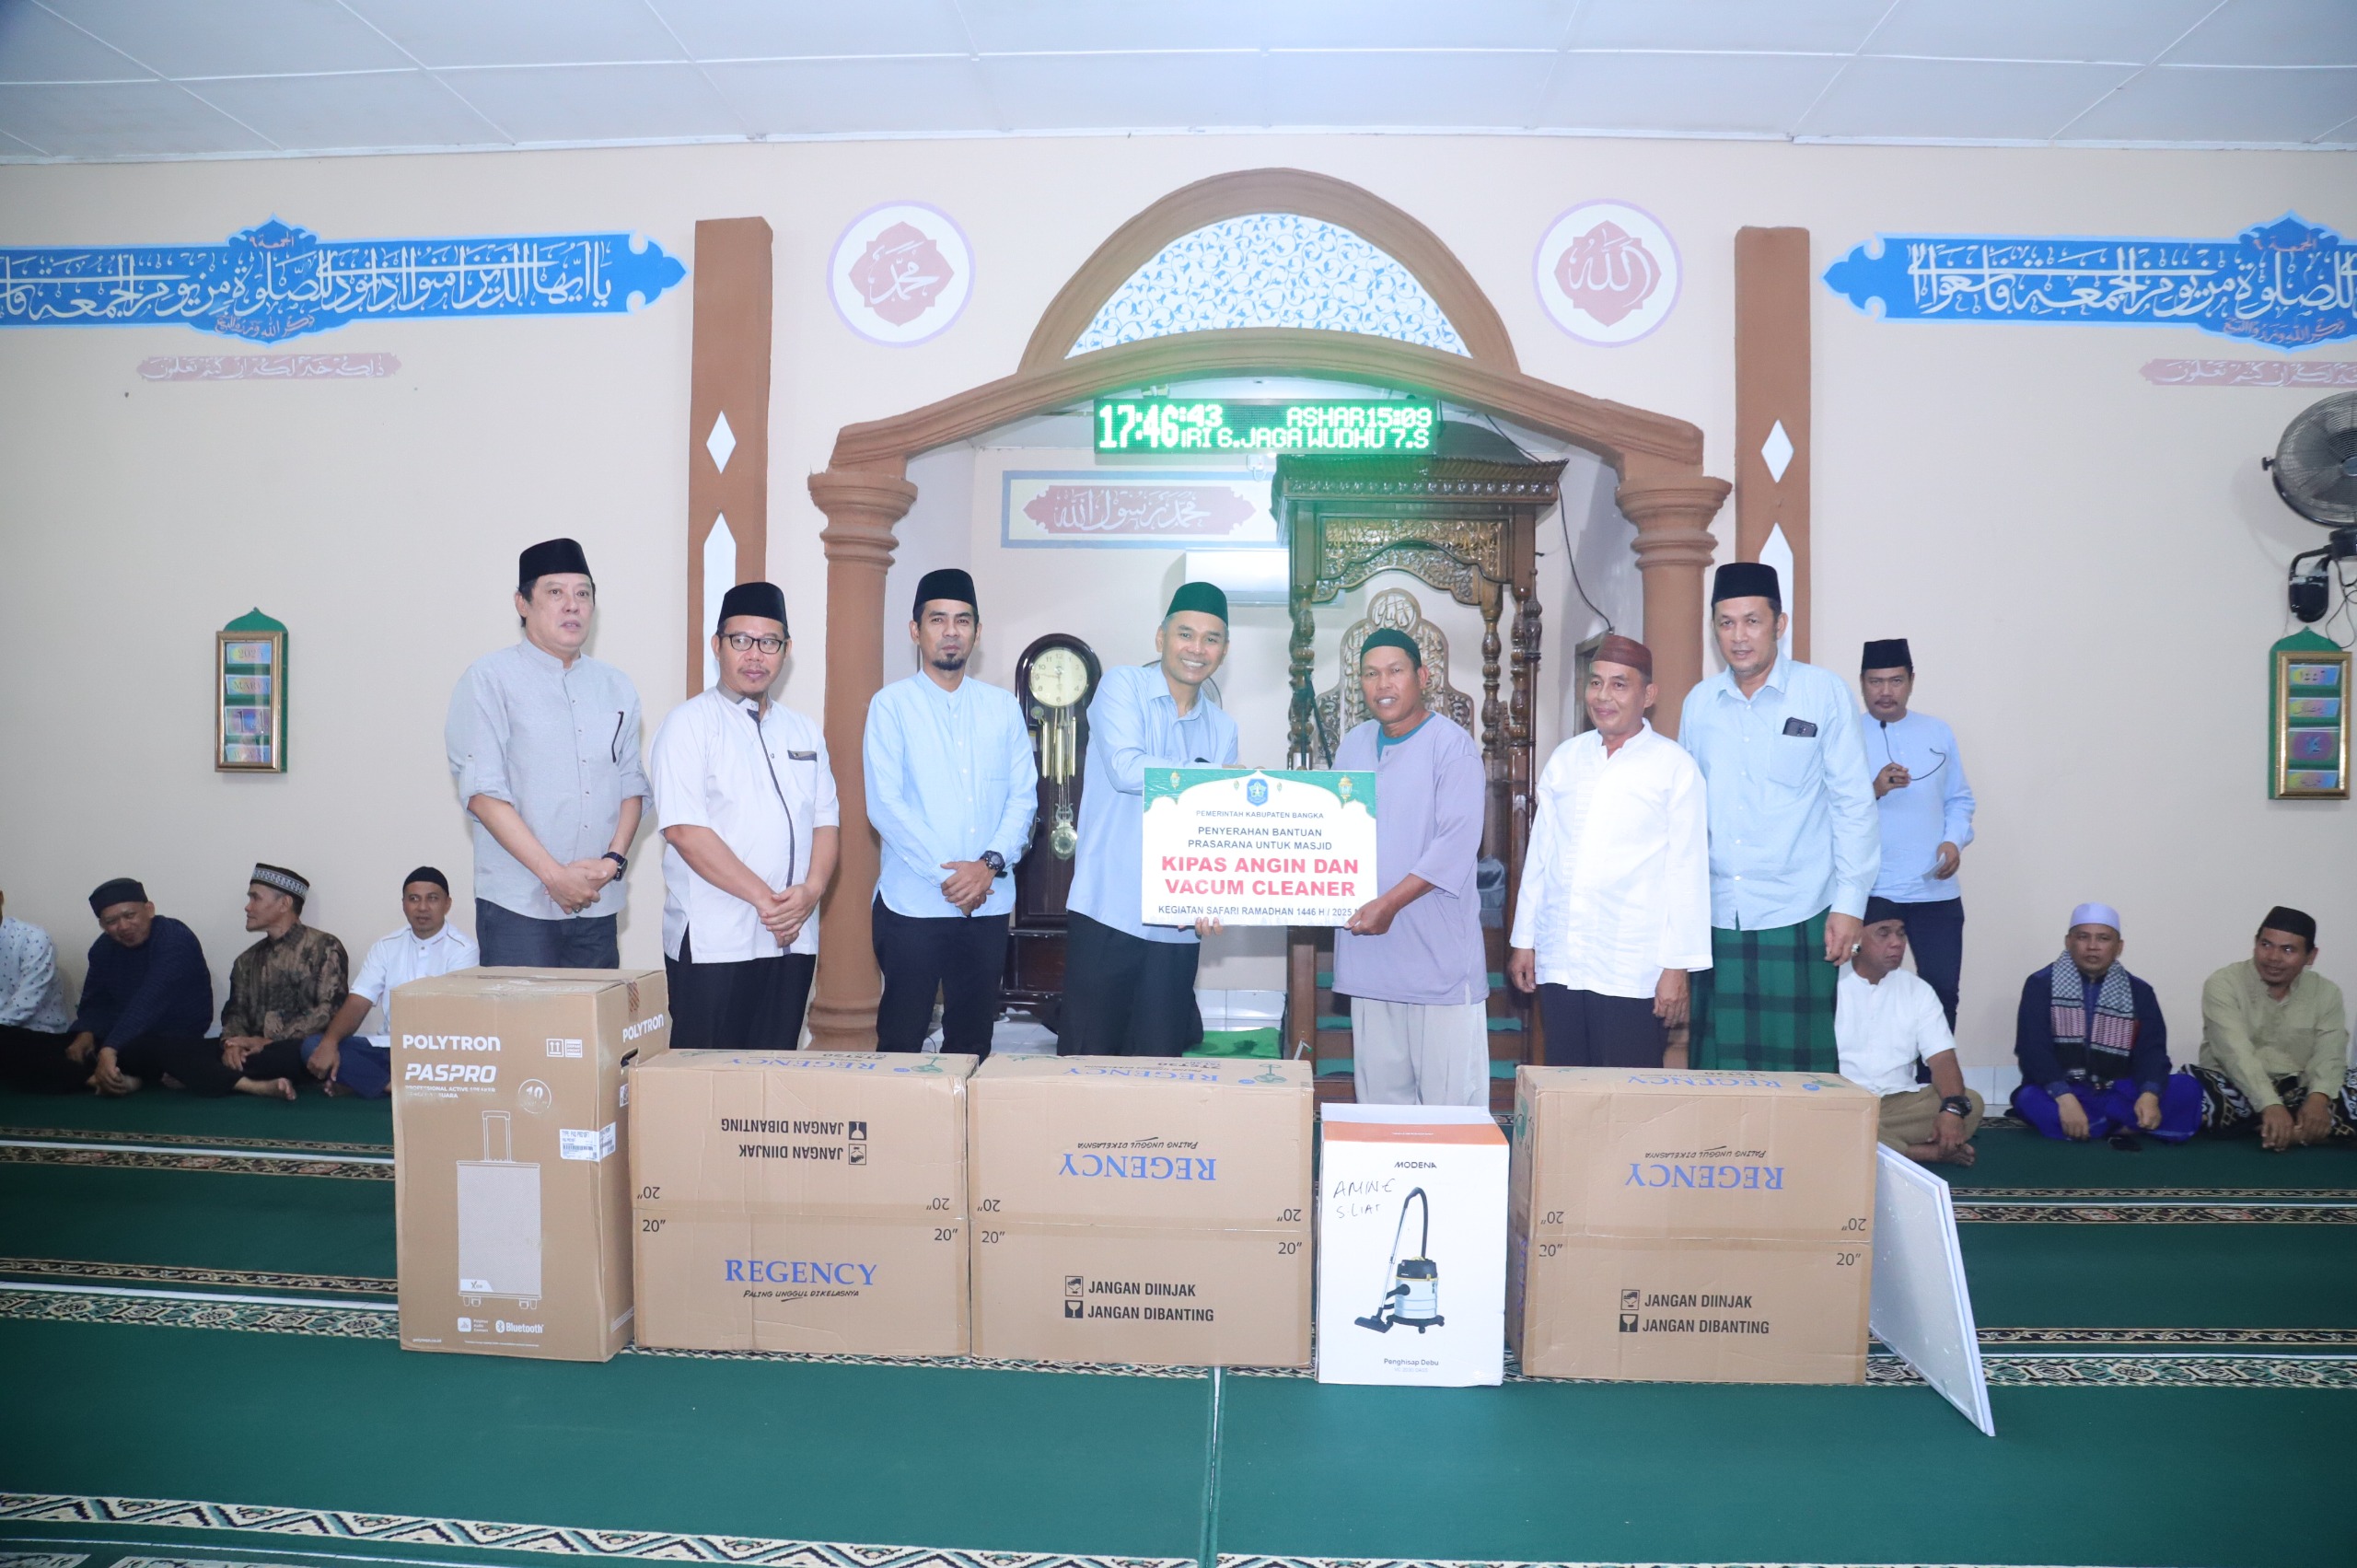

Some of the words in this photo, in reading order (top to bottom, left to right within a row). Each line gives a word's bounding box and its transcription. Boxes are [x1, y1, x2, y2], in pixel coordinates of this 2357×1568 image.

[1568, 227, 1652, 308] الله
[1286, 406, 1364, 428] ASHAR
[1307, 427, 1382, 448] WUDHU
[1198, 826, 1269, 837] PENYERAHAN
[1272, 828, 1322, 837] BANTUAN
[1188, 840, 1253, 849] PRASARANA
[1256, 841, 1291, 850] UNTUK
[1294, 842, 1332, 851] MASJID
[1162, 856, 1227, 872] KIPAS
[1234, 857, 1306, 874] ANGIN
[1315, 858, 1359, 875] DAN
[1165, 878, 1244, 895] VACUM
[1252, 880, 1355, 897] CLEANER
[1158, 905, 1204, 915] KEGIATAN
[1206, 906, 1239, 915] SAFARI
[1241, 906, 1294, 916] RAMADHAN
[1296, 907, 1317, 916] 1446
[1318, 908, 1326, 916] H
[1331, 908, 1353, 917] 2025
[622, 1013, 665, 1043] POLYTRON
[402, 1034, 501, 1051] POLYTRON
[726, 1057, 877, 1071] REGENCY
[405, 1063, 497, 1084] PASPRO
[1062, 1066, 1220, 1082] REGENCY
[1628, 1075, 1783, 1088] REGENCY
[722, 1118, 789, 1134] DIBANTING
[793, 1121, 844, 1135] JANGAN
[739, 1144, 789, 1159] DIINJAK
[793, 1145, 844, 1160] JANGAN
[1059, 1153, 1216, 1180] REGENCY
[1394, 1161, 1437, 1169] MODENA
[1624, 1164, 1785, 1191] REGENCY
[725, 1260, 877, 1285] REGENCY
[1088, 1281, 1141, 1295] JANGAN
[1145, 1282, 1196, 1296] DIINJAK
[1644, 1293, 1698, 1309] JANGAN
[1701, 1294, 1753, 1309] DIINJAK
[1088, 1306, 1141, 1320] JANGAN
[1144, 1306, 1213, 1322] DIBANTING
[505, 1322, 544, 1333] Bluetooth
[1643, 1318, 1695, 1334] JANGAN
[1699, 1318, 1770, 1335] DIBANTING
[1384, 1358, 1420, 1366] Penghisap
